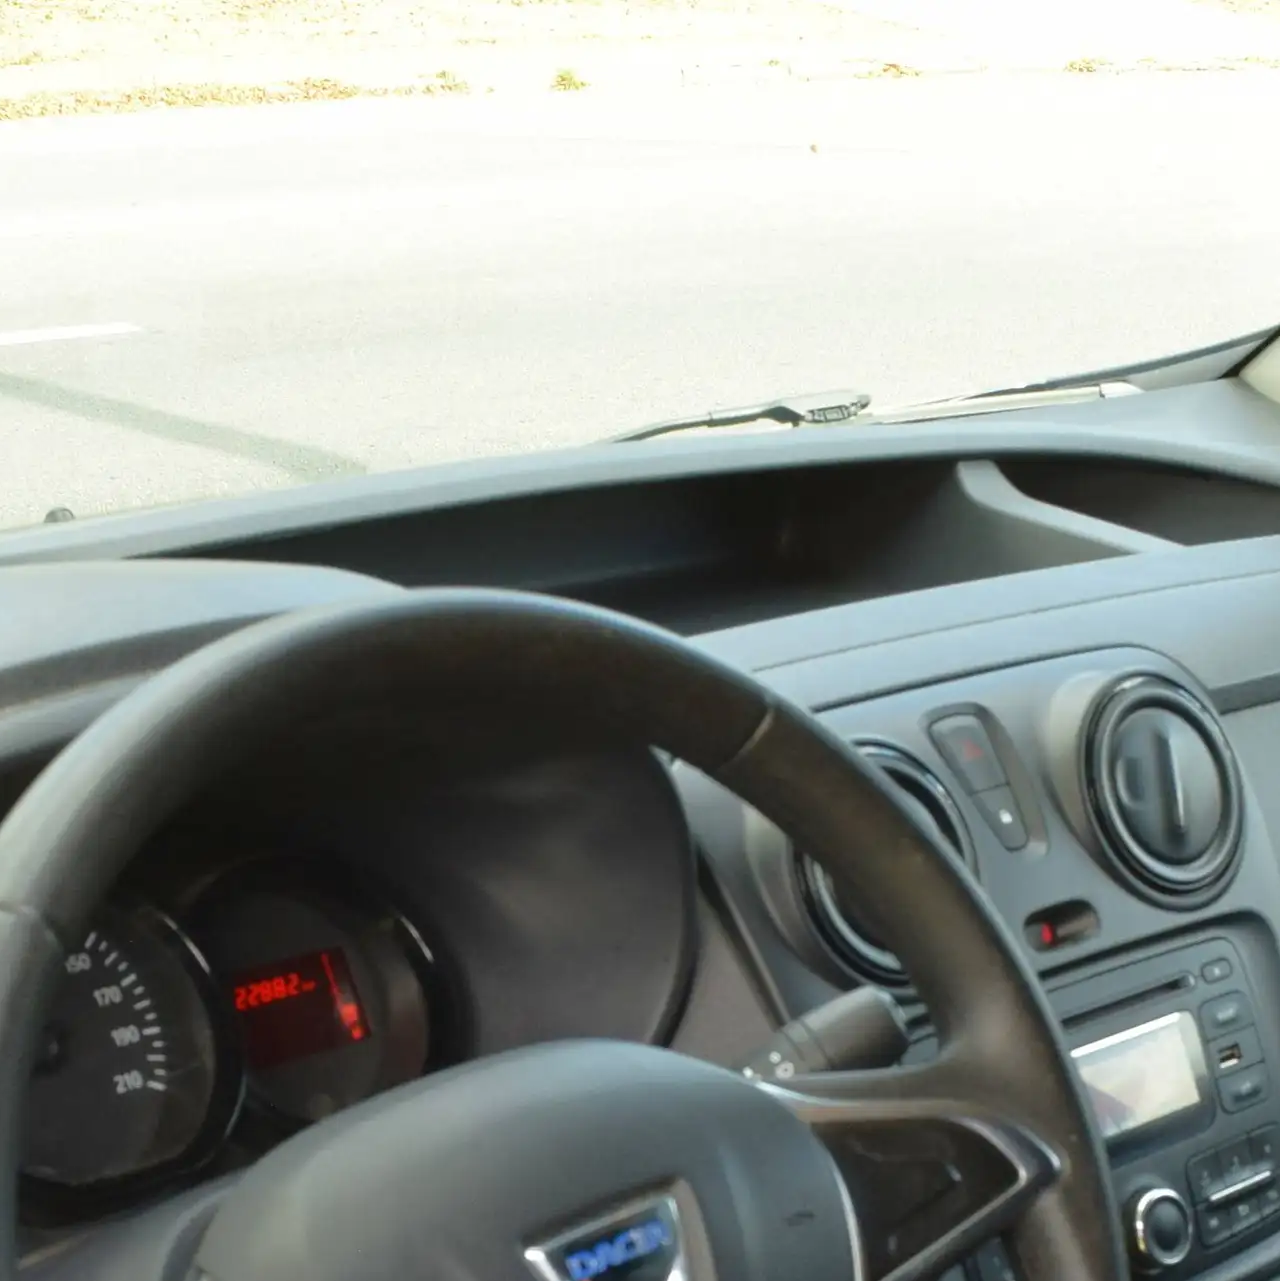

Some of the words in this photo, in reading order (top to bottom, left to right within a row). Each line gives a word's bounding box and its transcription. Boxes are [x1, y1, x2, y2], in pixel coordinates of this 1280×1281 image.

[93, 985, 123, 1007] 170
[111, 1024, 140, 1047] 190
[113, 1069, 144, 1095] 210
